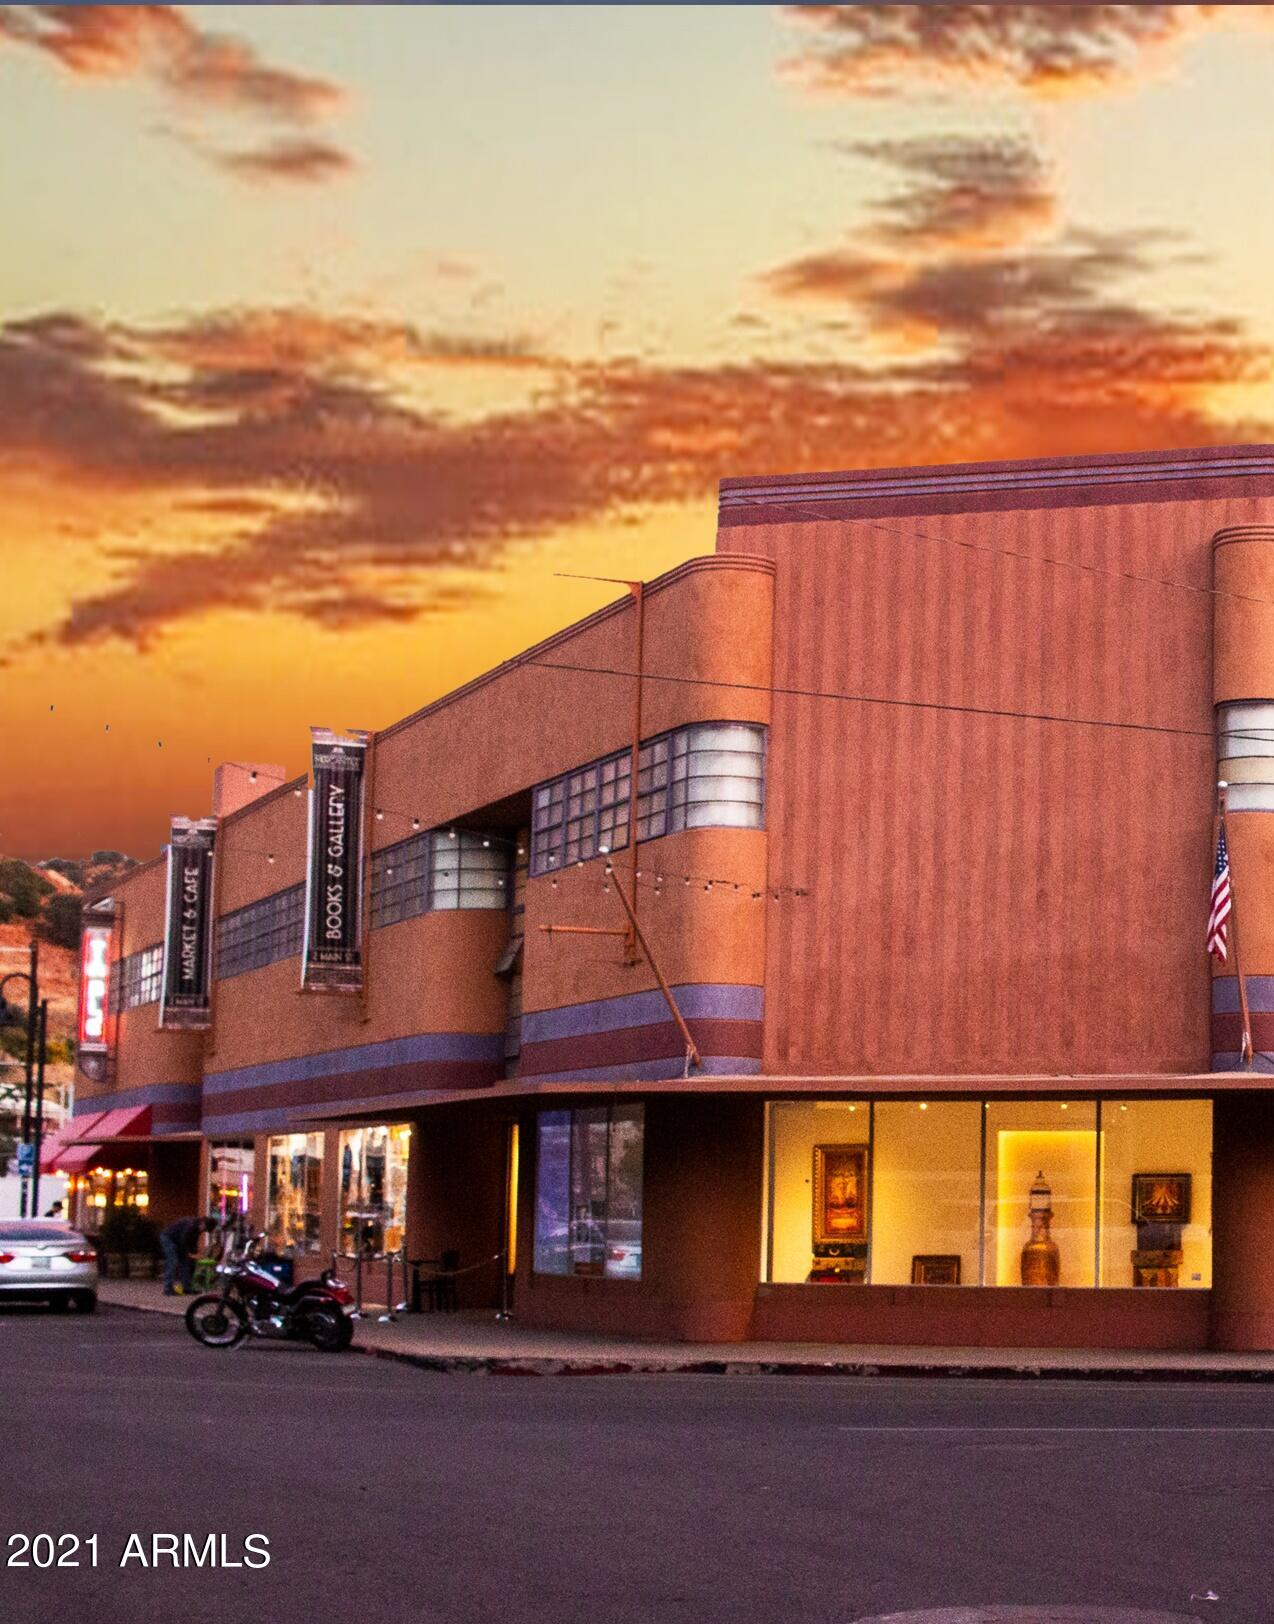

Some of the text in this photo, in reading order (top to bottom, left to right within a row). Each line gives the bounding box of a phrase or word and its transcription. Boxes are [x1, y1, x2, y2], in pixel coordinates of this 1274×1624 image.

[184, 867, 199, 903] CAFE
[326, 784, 344, 940] BOOKS & GALLERY
[183, 908, 198, 919] &
[181, 925, 198, 981] MARKET
